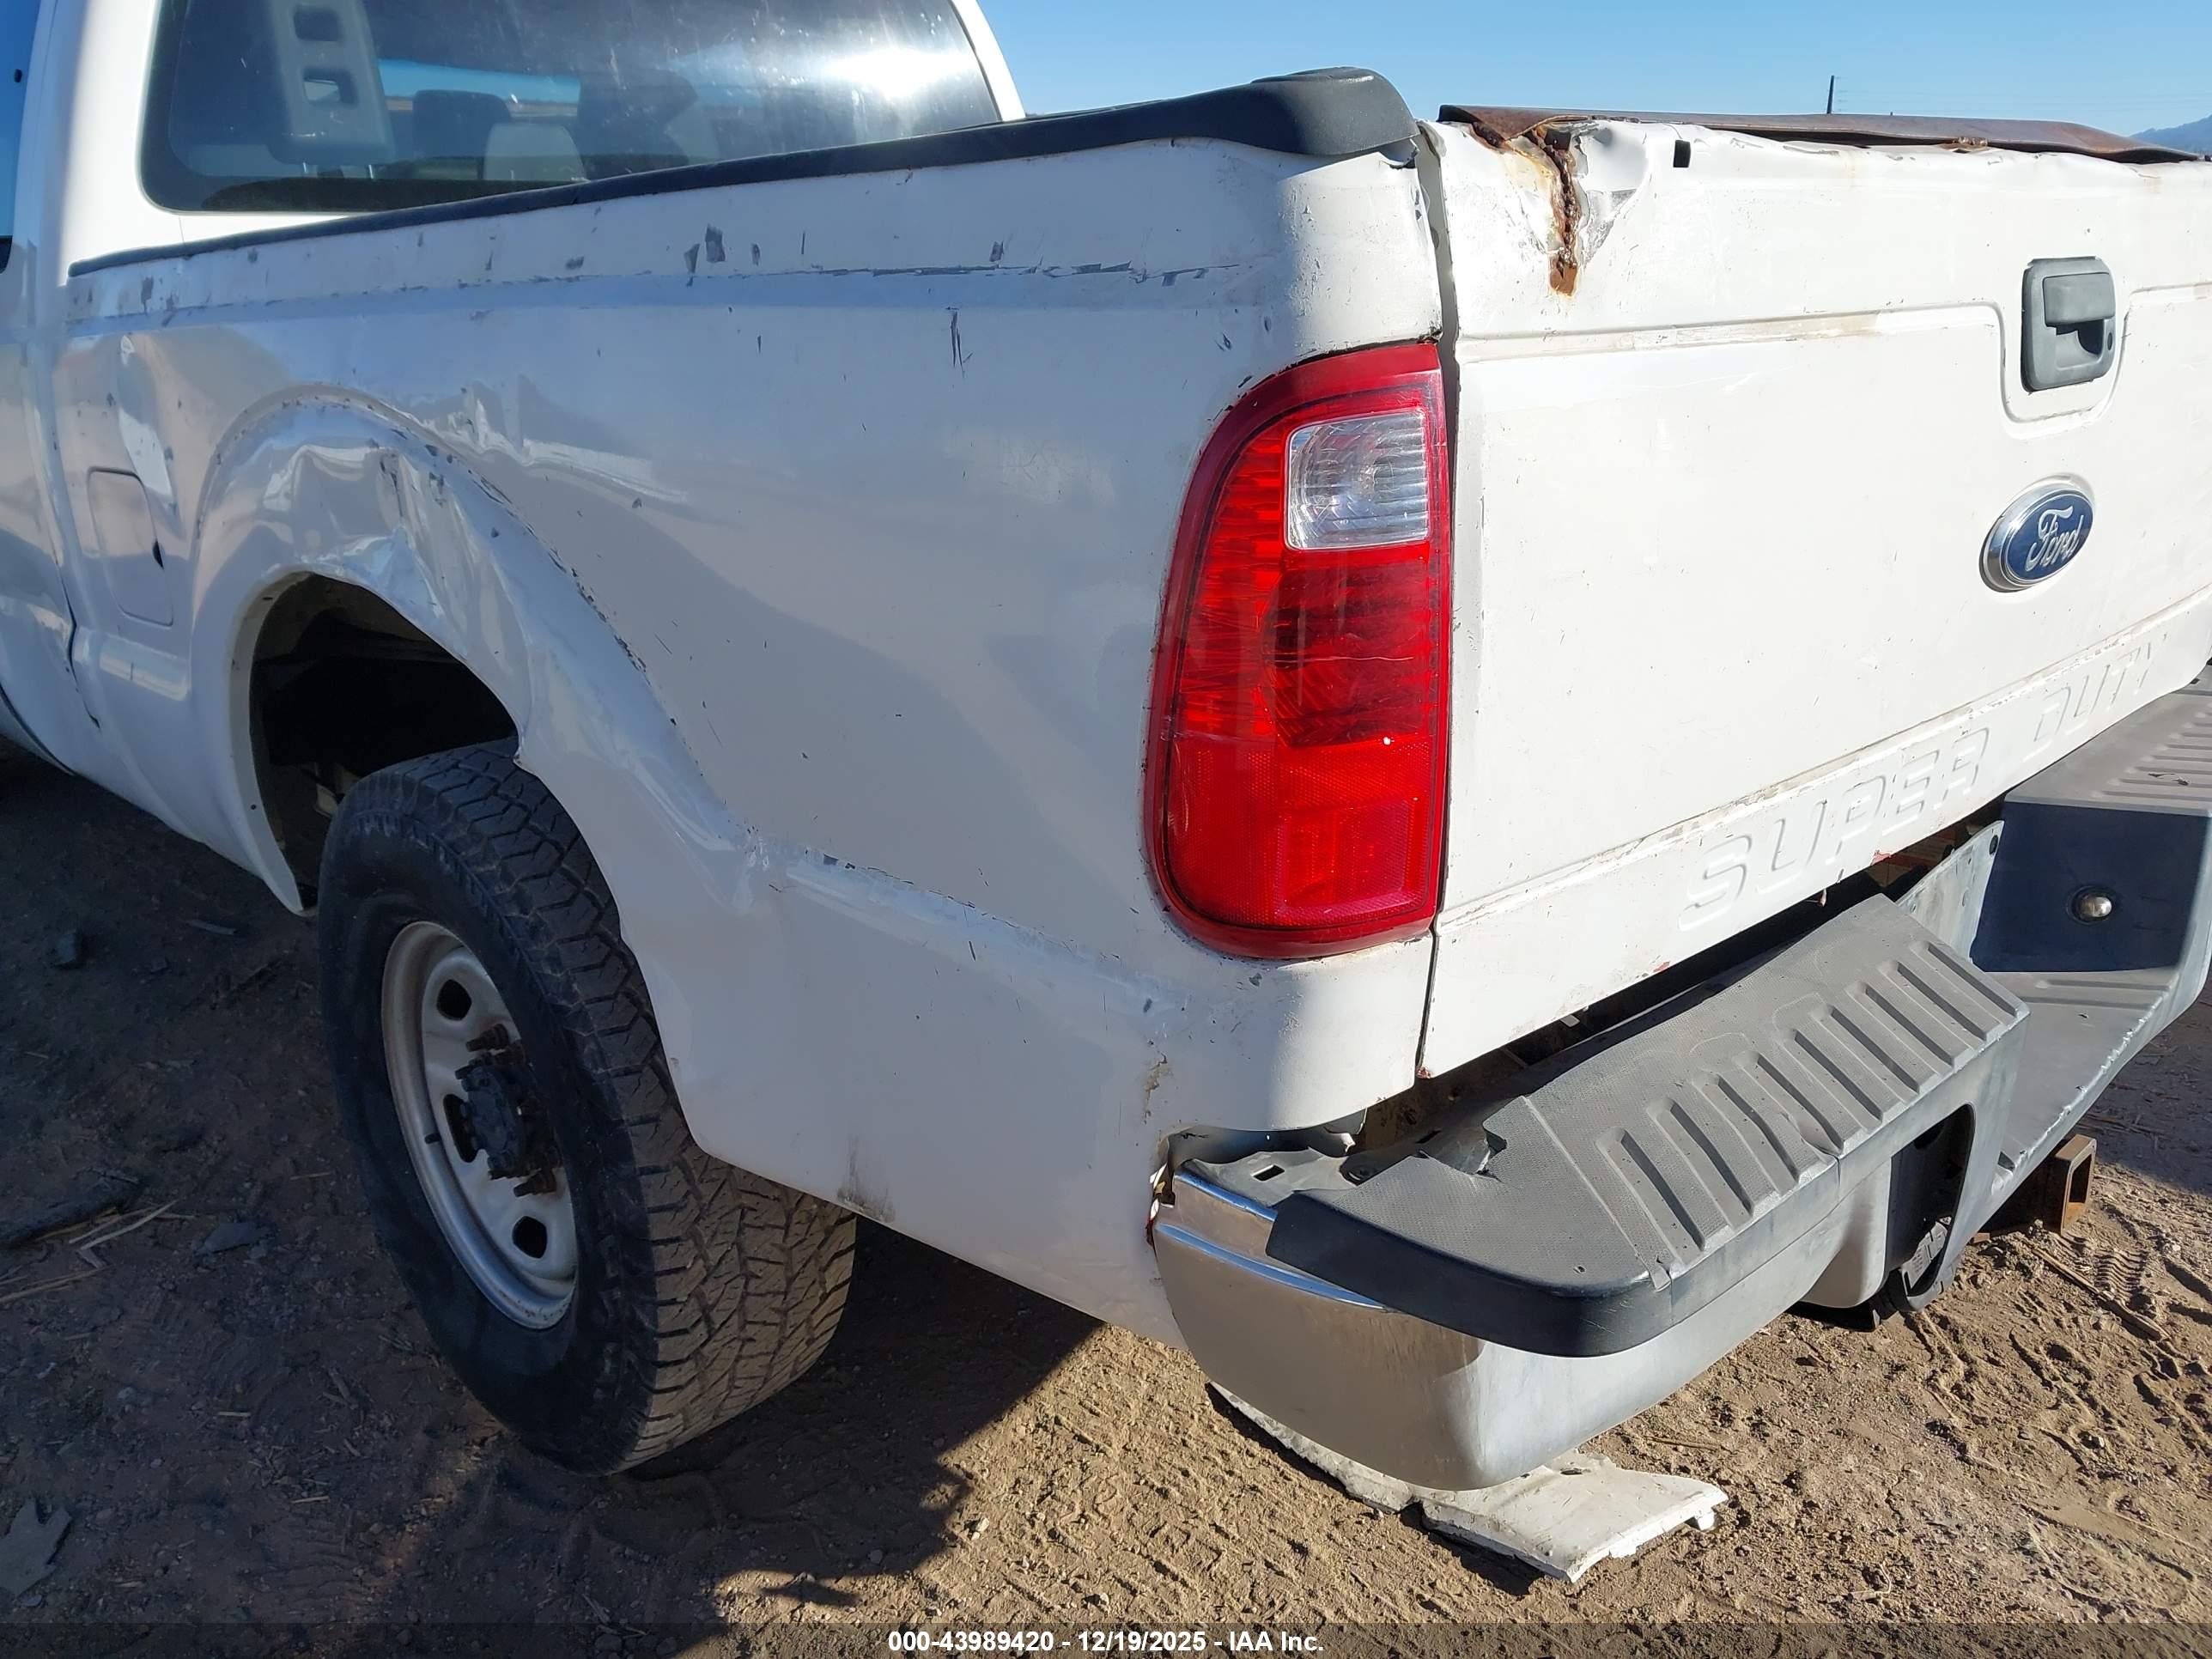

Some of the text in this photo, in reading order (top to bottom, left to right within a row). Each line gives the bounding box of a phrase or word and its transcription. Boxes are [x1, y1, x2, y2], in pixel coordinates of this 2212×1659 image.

[2024, 505, 2084, 573] Ford
[1677, 634, 2168, 931] SUPER DUTY
